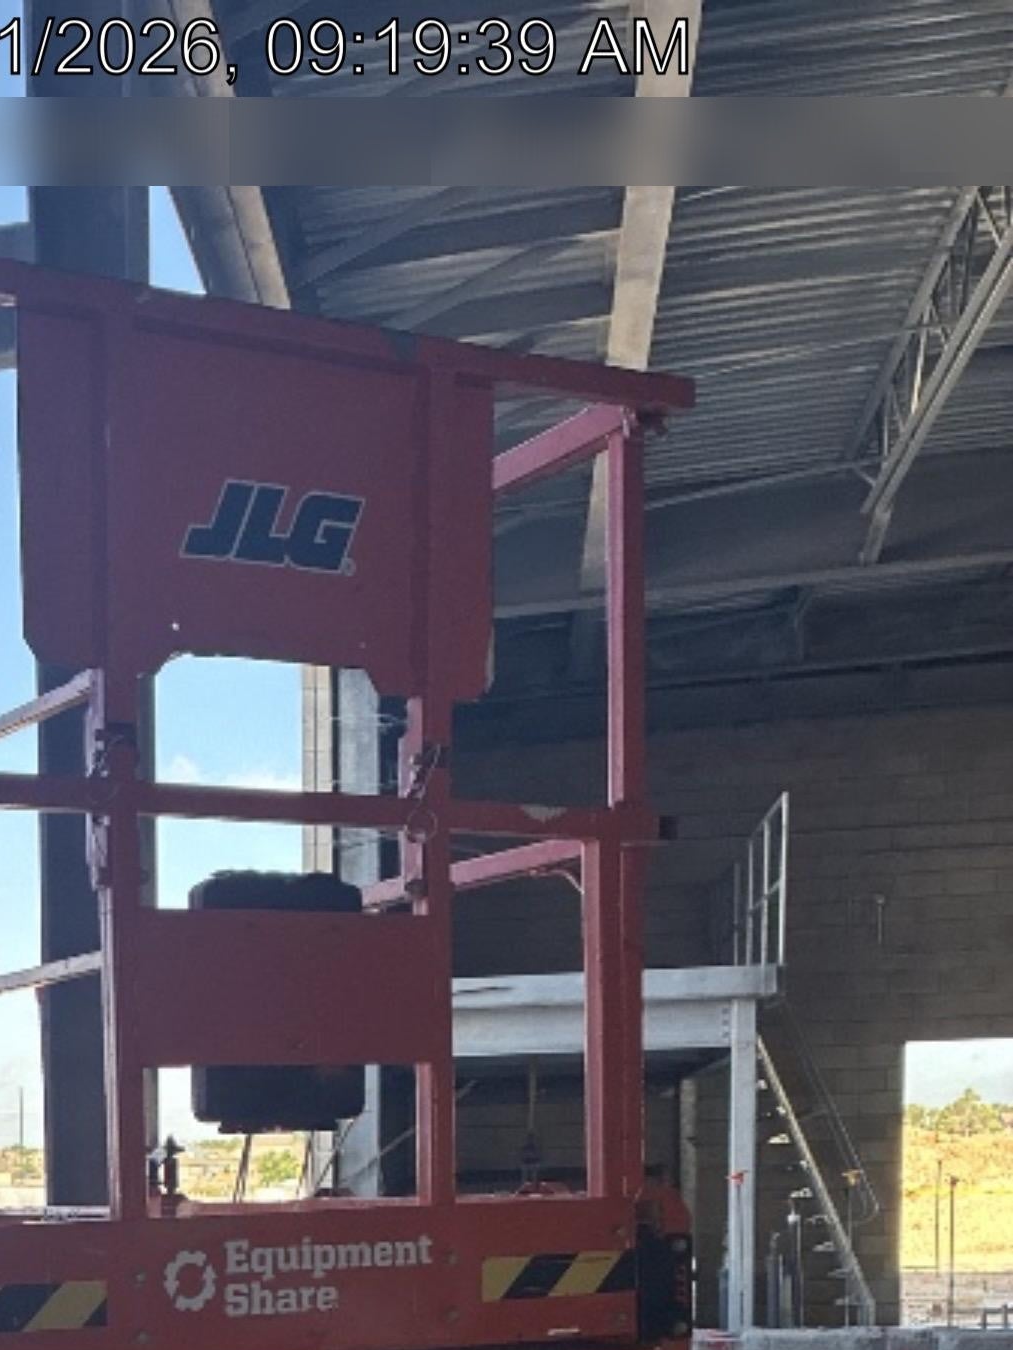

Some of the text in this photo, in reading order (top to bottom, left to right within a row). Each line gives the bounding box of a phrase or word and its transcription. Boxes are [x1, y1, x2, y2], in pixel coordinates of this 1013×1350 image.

[179, 478, 366, 575] JLG
[223, 1235, 433, 1281] Equipment
[223, 1282, 340, 1318] Share
